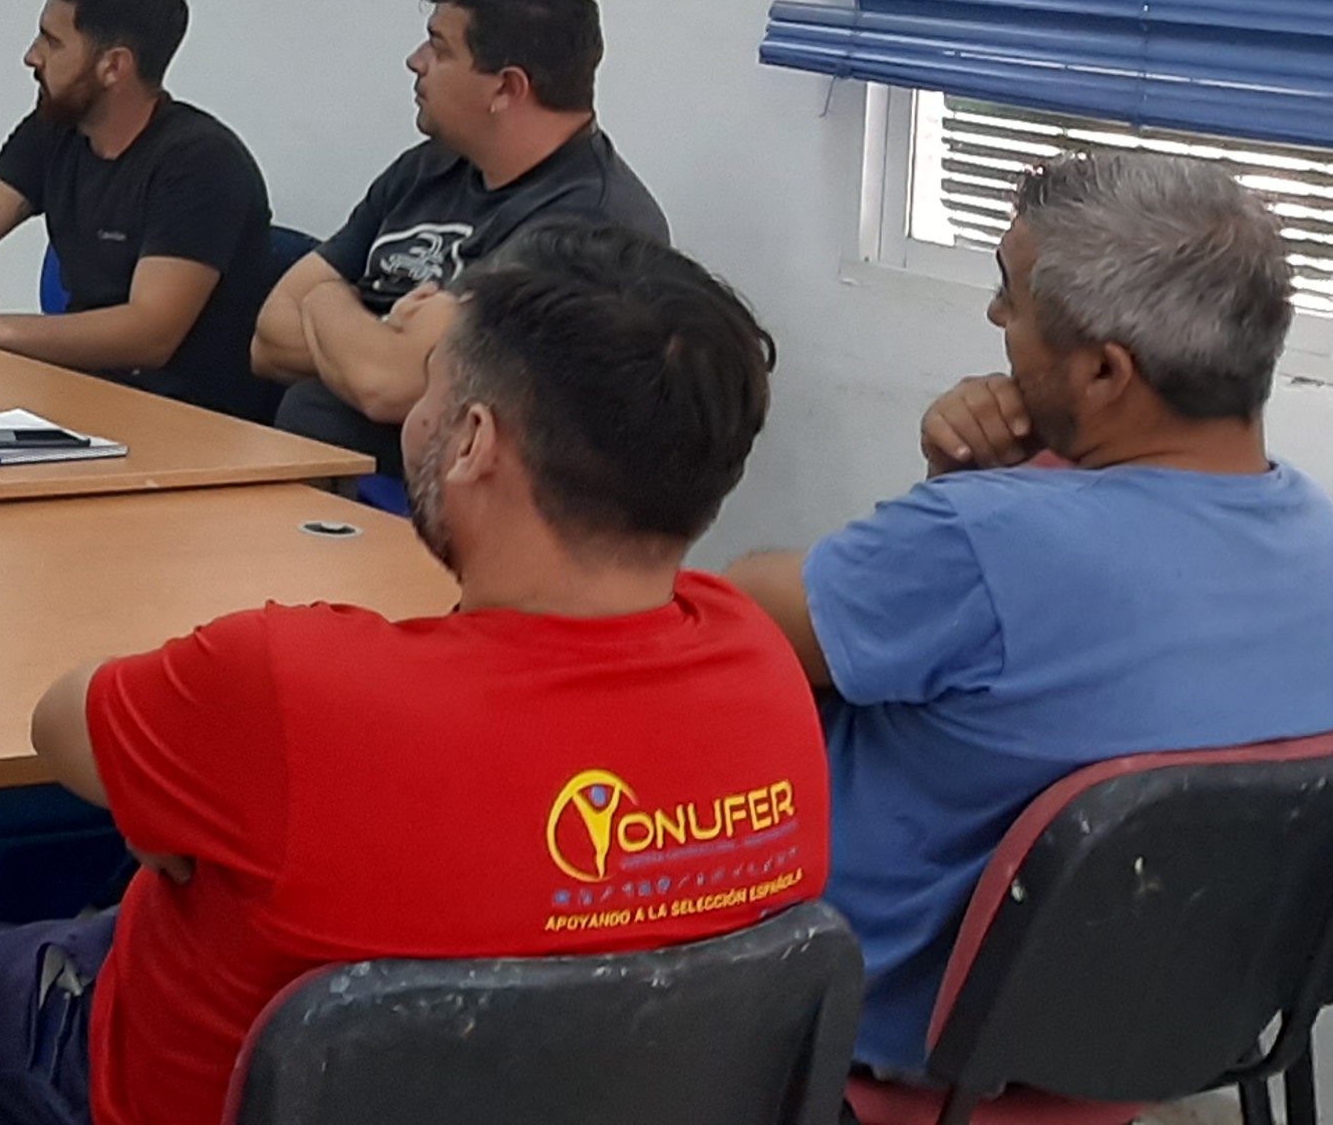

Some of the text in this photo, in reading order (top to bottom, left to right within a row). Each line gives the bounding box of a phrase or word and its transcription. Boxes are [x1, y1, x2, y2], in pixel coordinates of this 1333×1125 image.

[544, 910, 631, 931] APOYANDO
[634, 906, 645, 922] A
[648, 902, 667, 920] LA
[671, 887, 747, 917] SELECCIÓN
